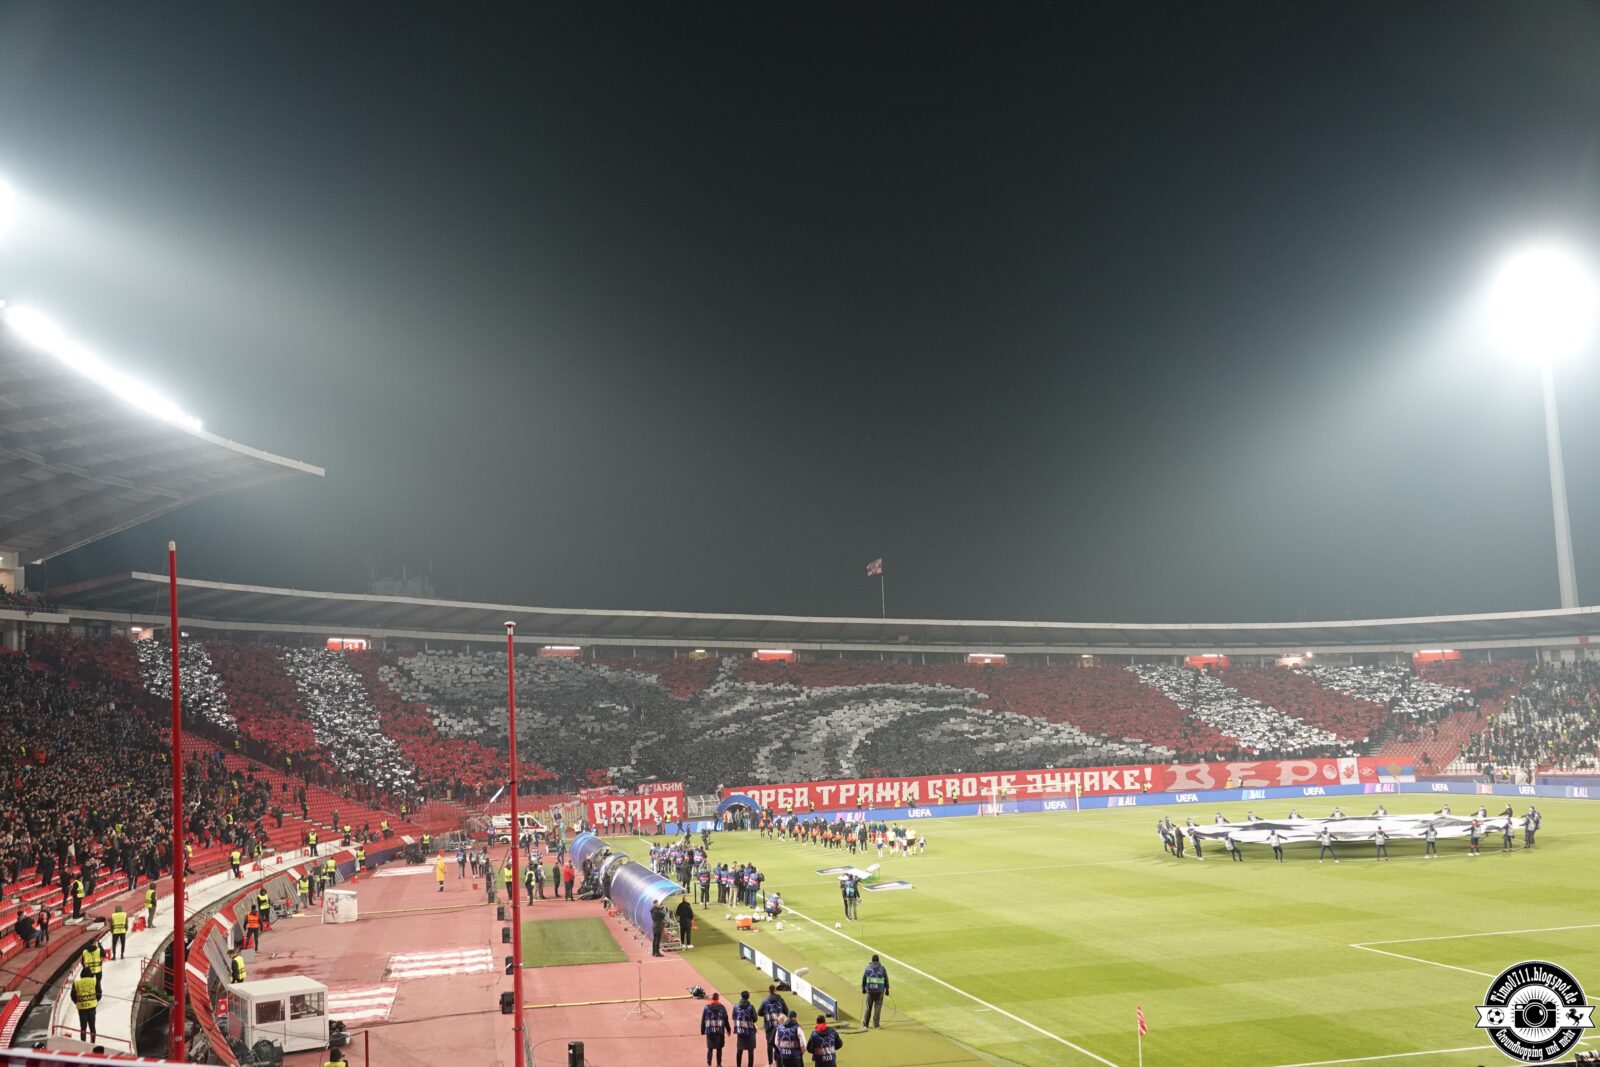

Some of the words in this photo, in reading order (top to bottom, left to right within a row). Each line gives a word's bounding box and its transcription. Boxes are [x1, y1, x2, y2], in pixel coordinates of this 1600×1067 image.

[1303, 786, 1325, 796] UEFA
[1432, 783, 1449, 792] UEFA
[1519, 786, 1535, 795] UEFA
[730, 787, 809, 810] ОРБА
[1175, 793, 1198, 803] UEFA
[1044, 800, 1067, 811] UEFA
[908, 808, 931, 818] UEFA
